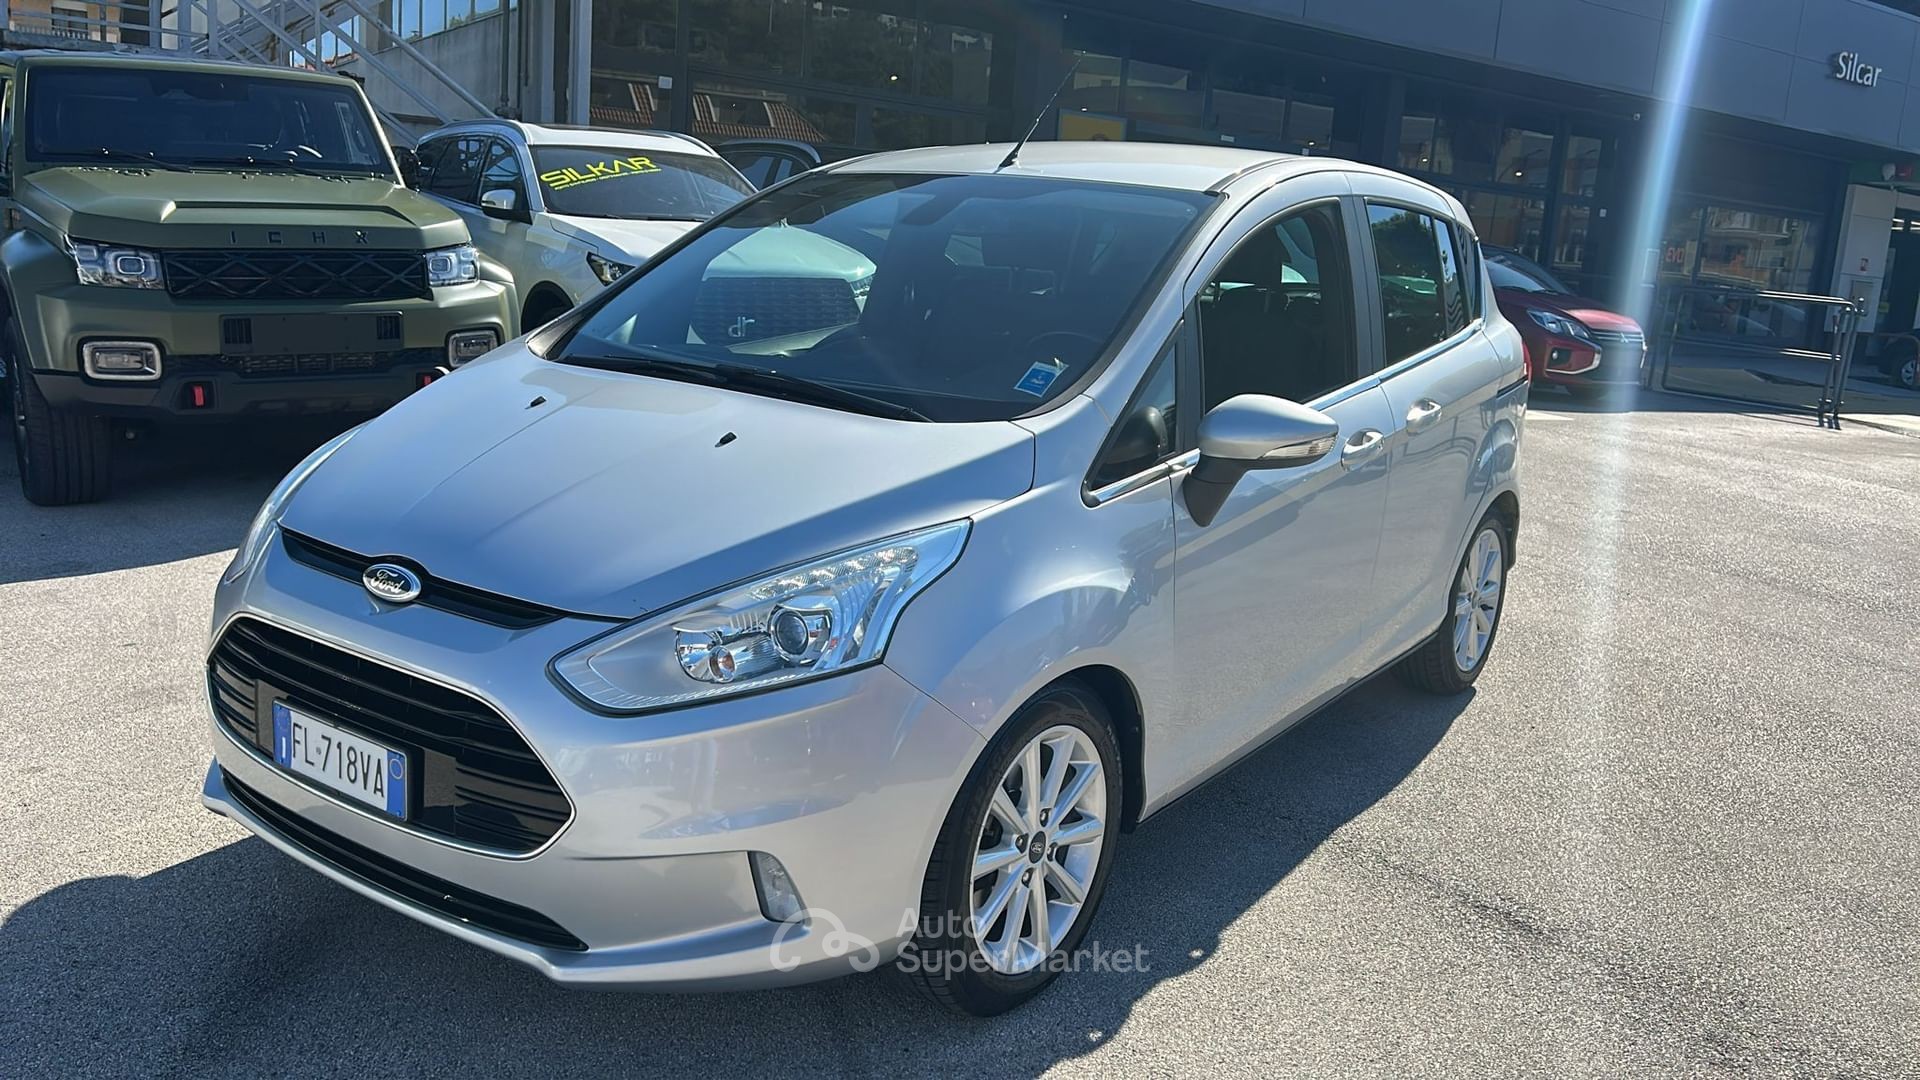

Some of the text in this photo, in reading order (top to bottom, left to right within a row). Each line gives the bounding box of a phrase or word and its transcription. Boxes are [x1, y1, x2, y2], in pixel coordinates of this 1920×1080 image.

[1836, 51, 1882, 87] Silcar
[540, 156, 657, 187] SILKAR
[370, 569, 405, 594] Ford
